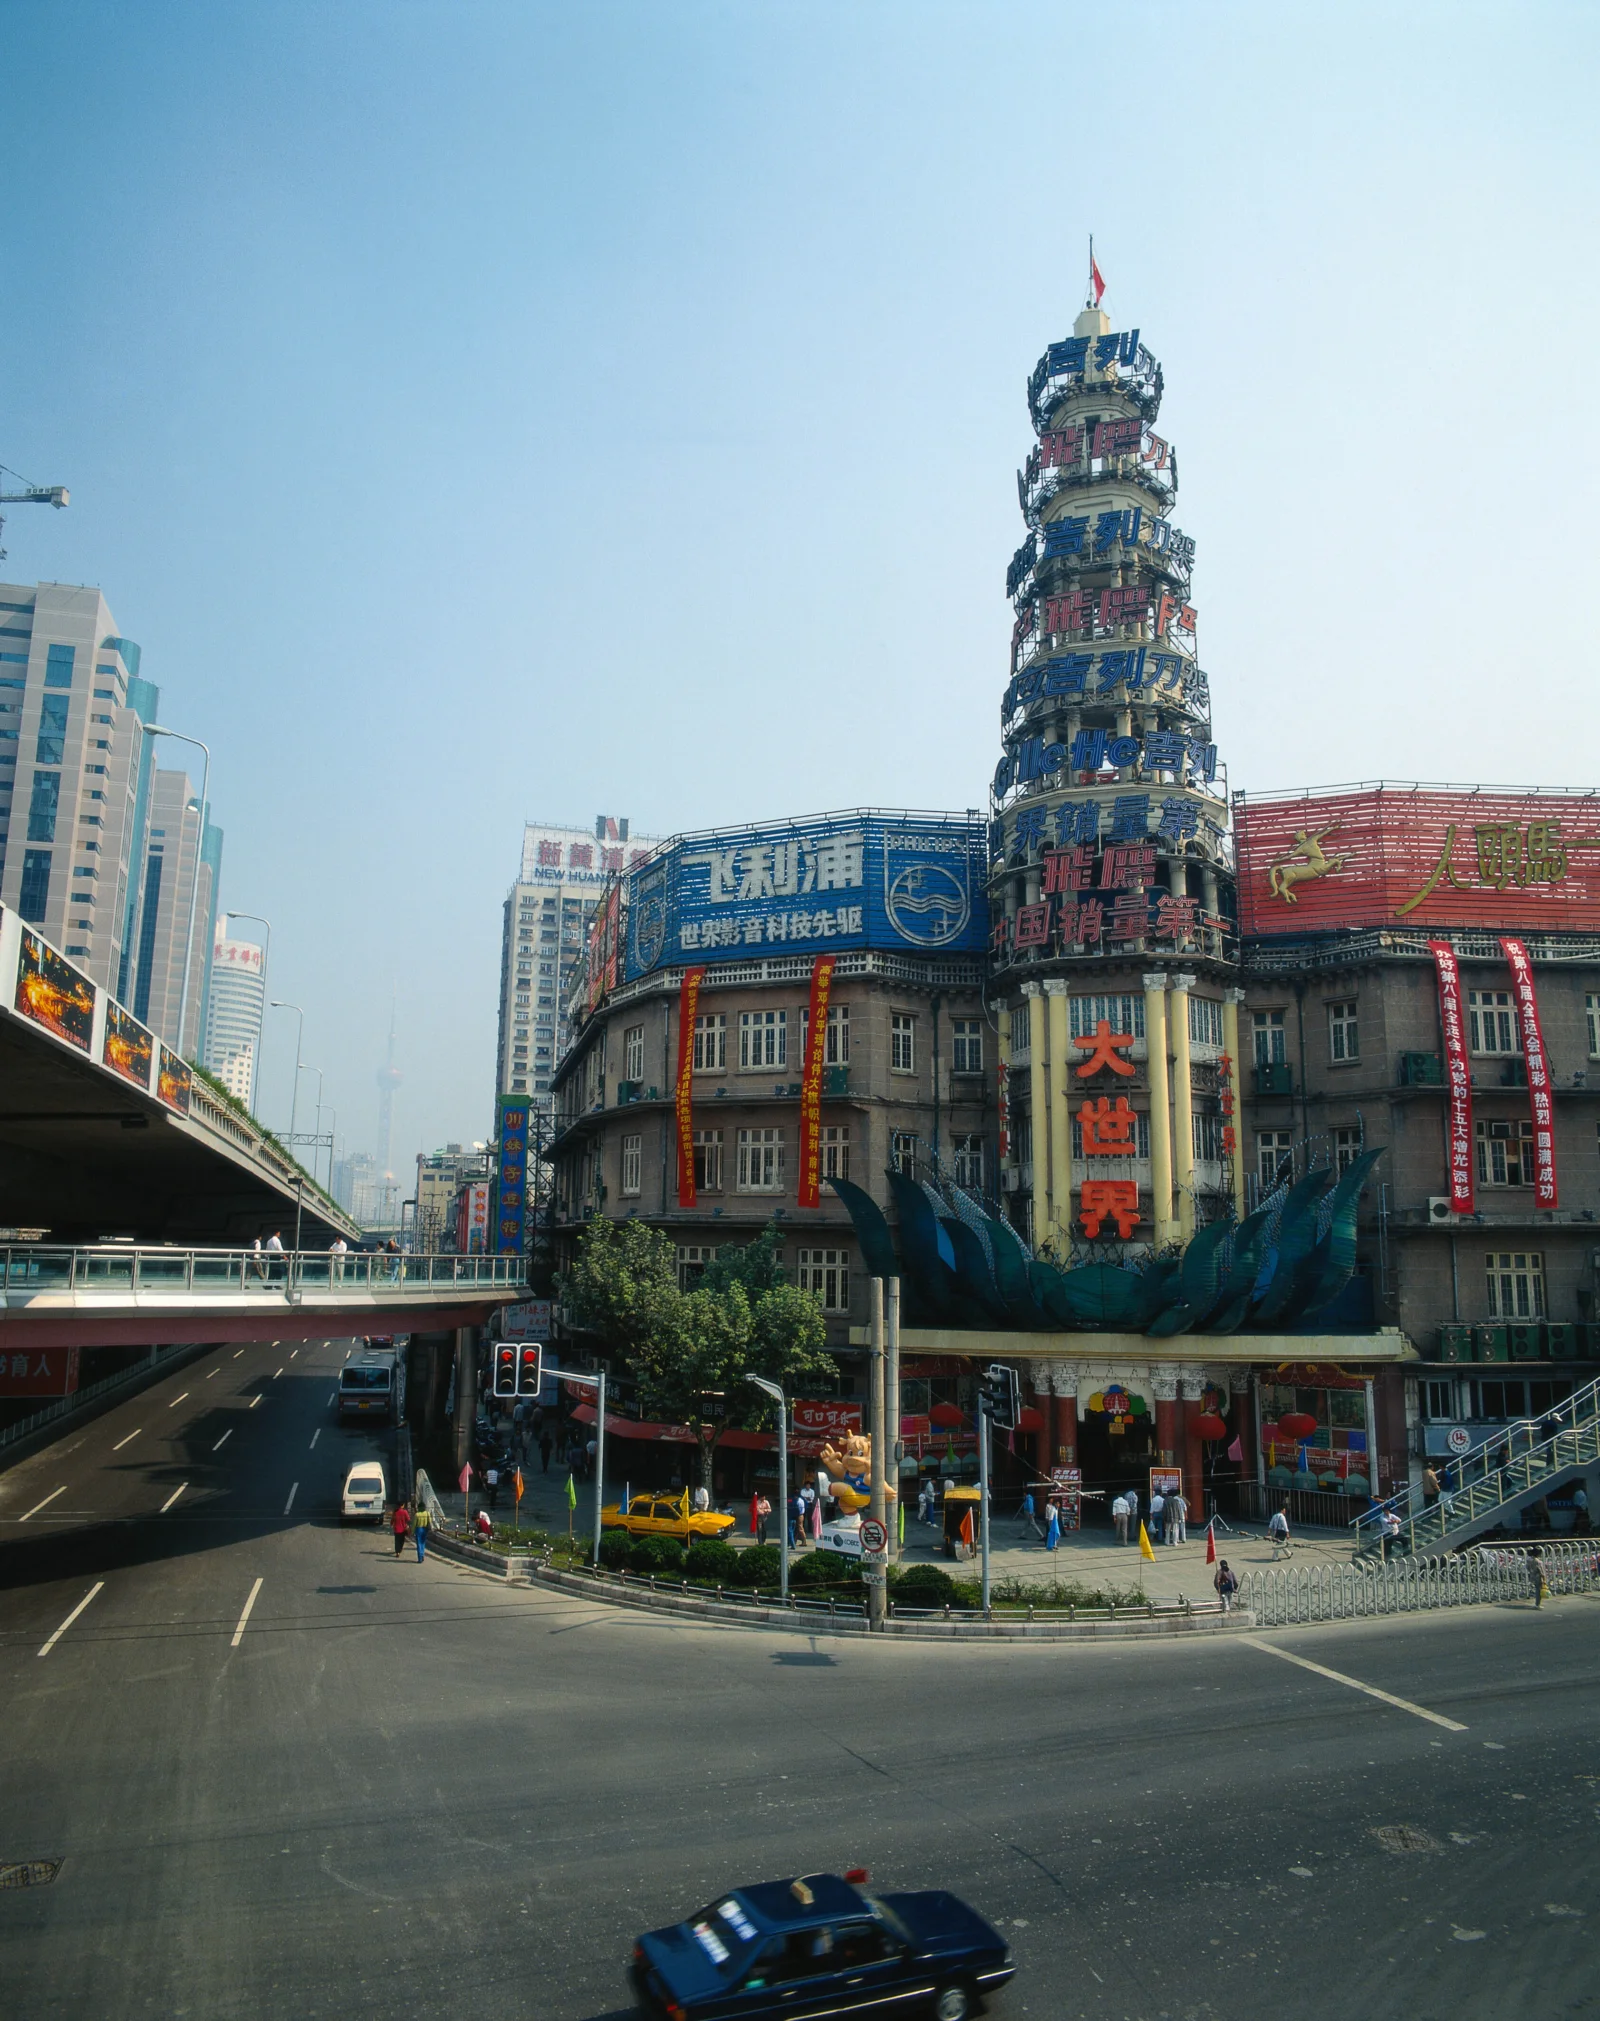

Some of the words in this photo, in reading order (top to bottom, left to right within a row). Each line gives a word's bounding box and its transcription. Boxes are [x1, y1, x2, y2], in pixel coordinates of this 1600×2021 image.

[1143, 730, 1219, 783] 吉列
[890, 834, 967, 853] PHILIPS
[534, 867, 565, 881] NEW
[680, 831, 865, 903] 飞利浦
[678, 905, 864, 950] 世界影音科技先驱
[1217, 1050, 1237, 1155] 大世界
[1073, 1020, 1141, 1239] 大世界
[703, 1403, 725, 1416] 回民
[802, 1409, 851, 1426] 可口可乐
